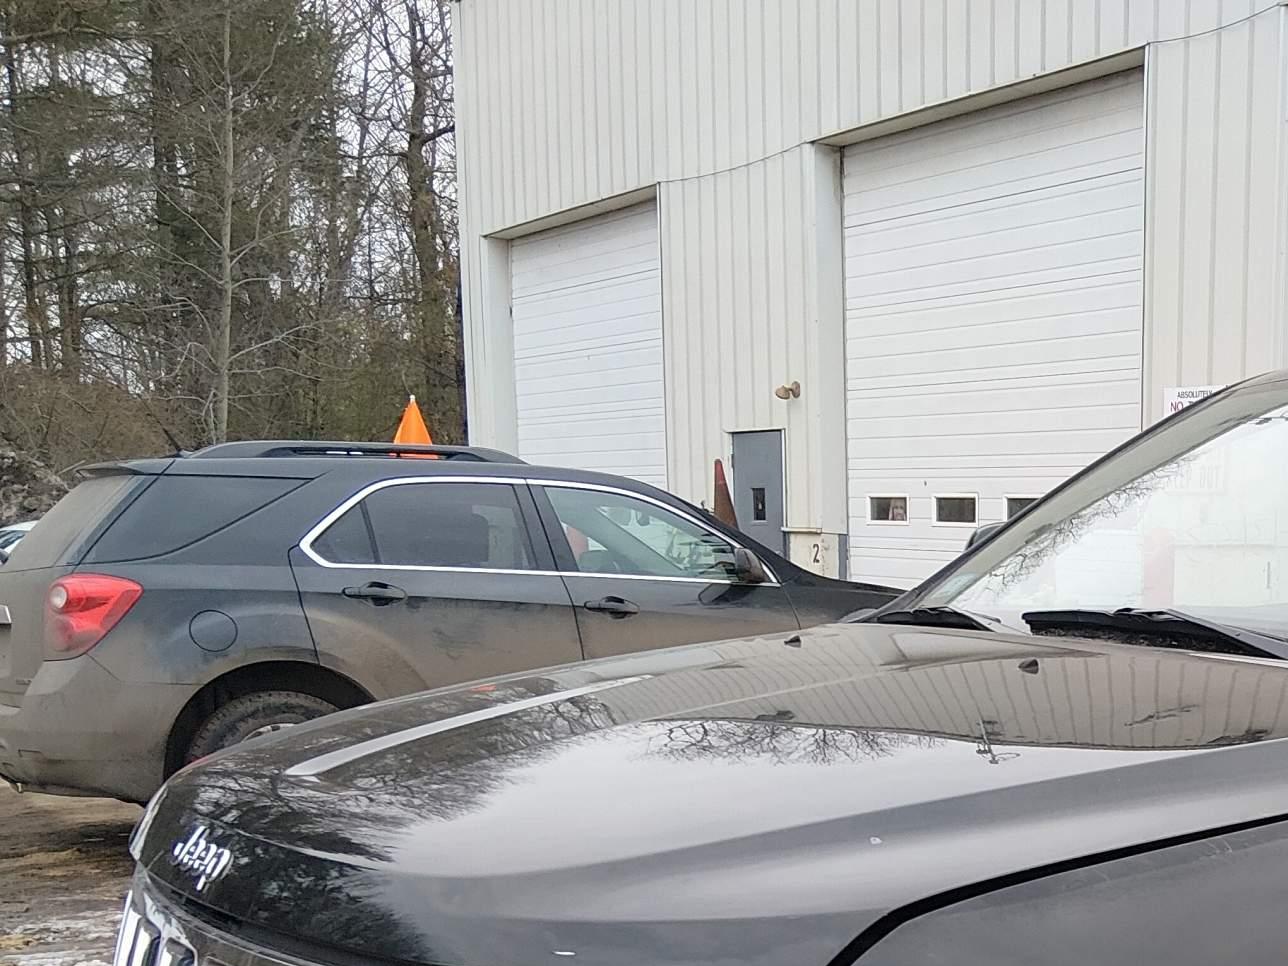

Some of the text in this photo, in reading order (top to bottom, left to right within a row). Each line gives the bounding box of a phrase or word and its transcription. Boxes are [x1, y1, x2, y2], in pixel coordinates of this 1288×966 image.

[1170, 401, 1184, 412] NO
[812, 543, 820, 564] 2
[173, 825, 231, 891] Jeep
